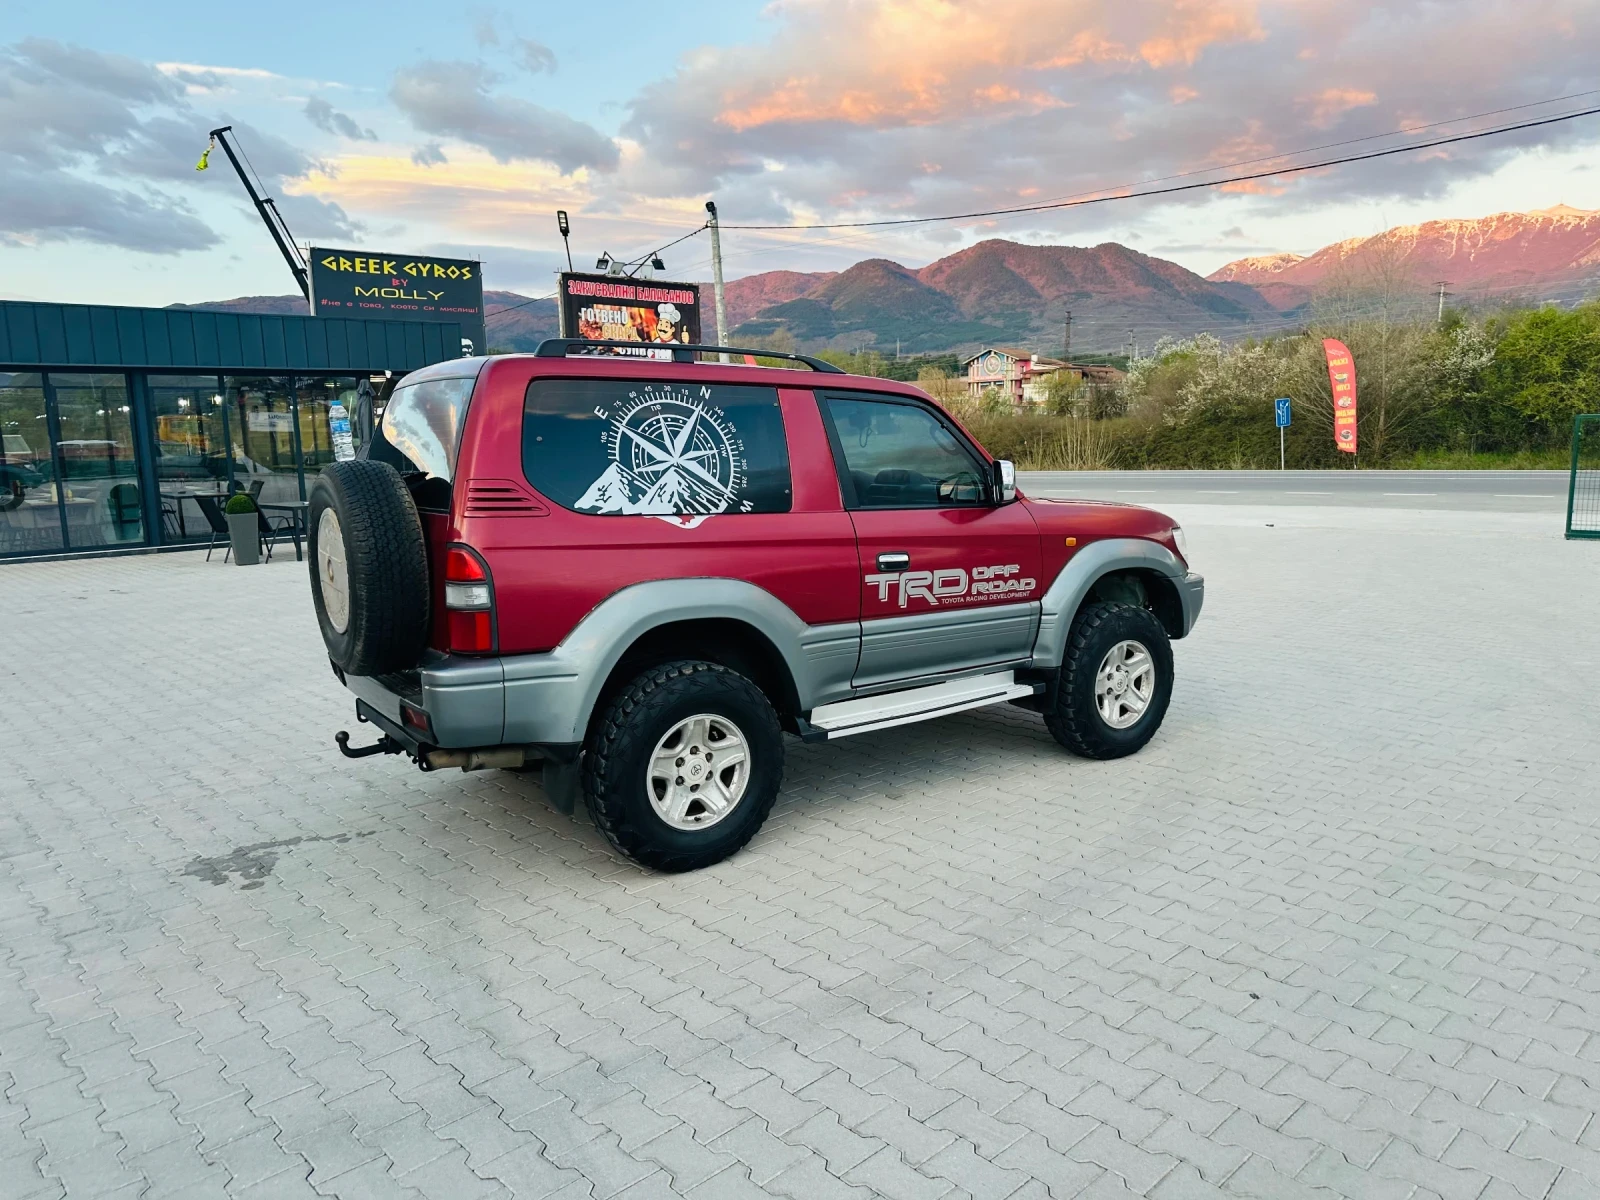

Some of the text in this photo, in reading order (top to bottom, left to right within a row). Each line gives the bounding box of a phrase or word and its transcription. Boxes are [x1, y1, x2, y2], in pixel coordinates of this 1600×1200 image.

[321, 256, 472, 280] GREEK GYROS
[392, 278, 408, 287] BY
[355, 286, 444, 300] MOLLY
[568, 280, 694, 304] ЗАКУСВАЛНЯ БАЛАБАНОВ
[580, 307, 628, 324] ГОТВЕНО
[602, 324, 638, 339] СКАРА
[700, 386, 711, 400] N
[594, 406, 609, 420] E
[972, 564, 1020, 580] OFF
[865, 568, 969, 608] TRD
[972, 578, 1036, 594] ROAD
[989, 591, 1031, 600] DEVELOPMENT
